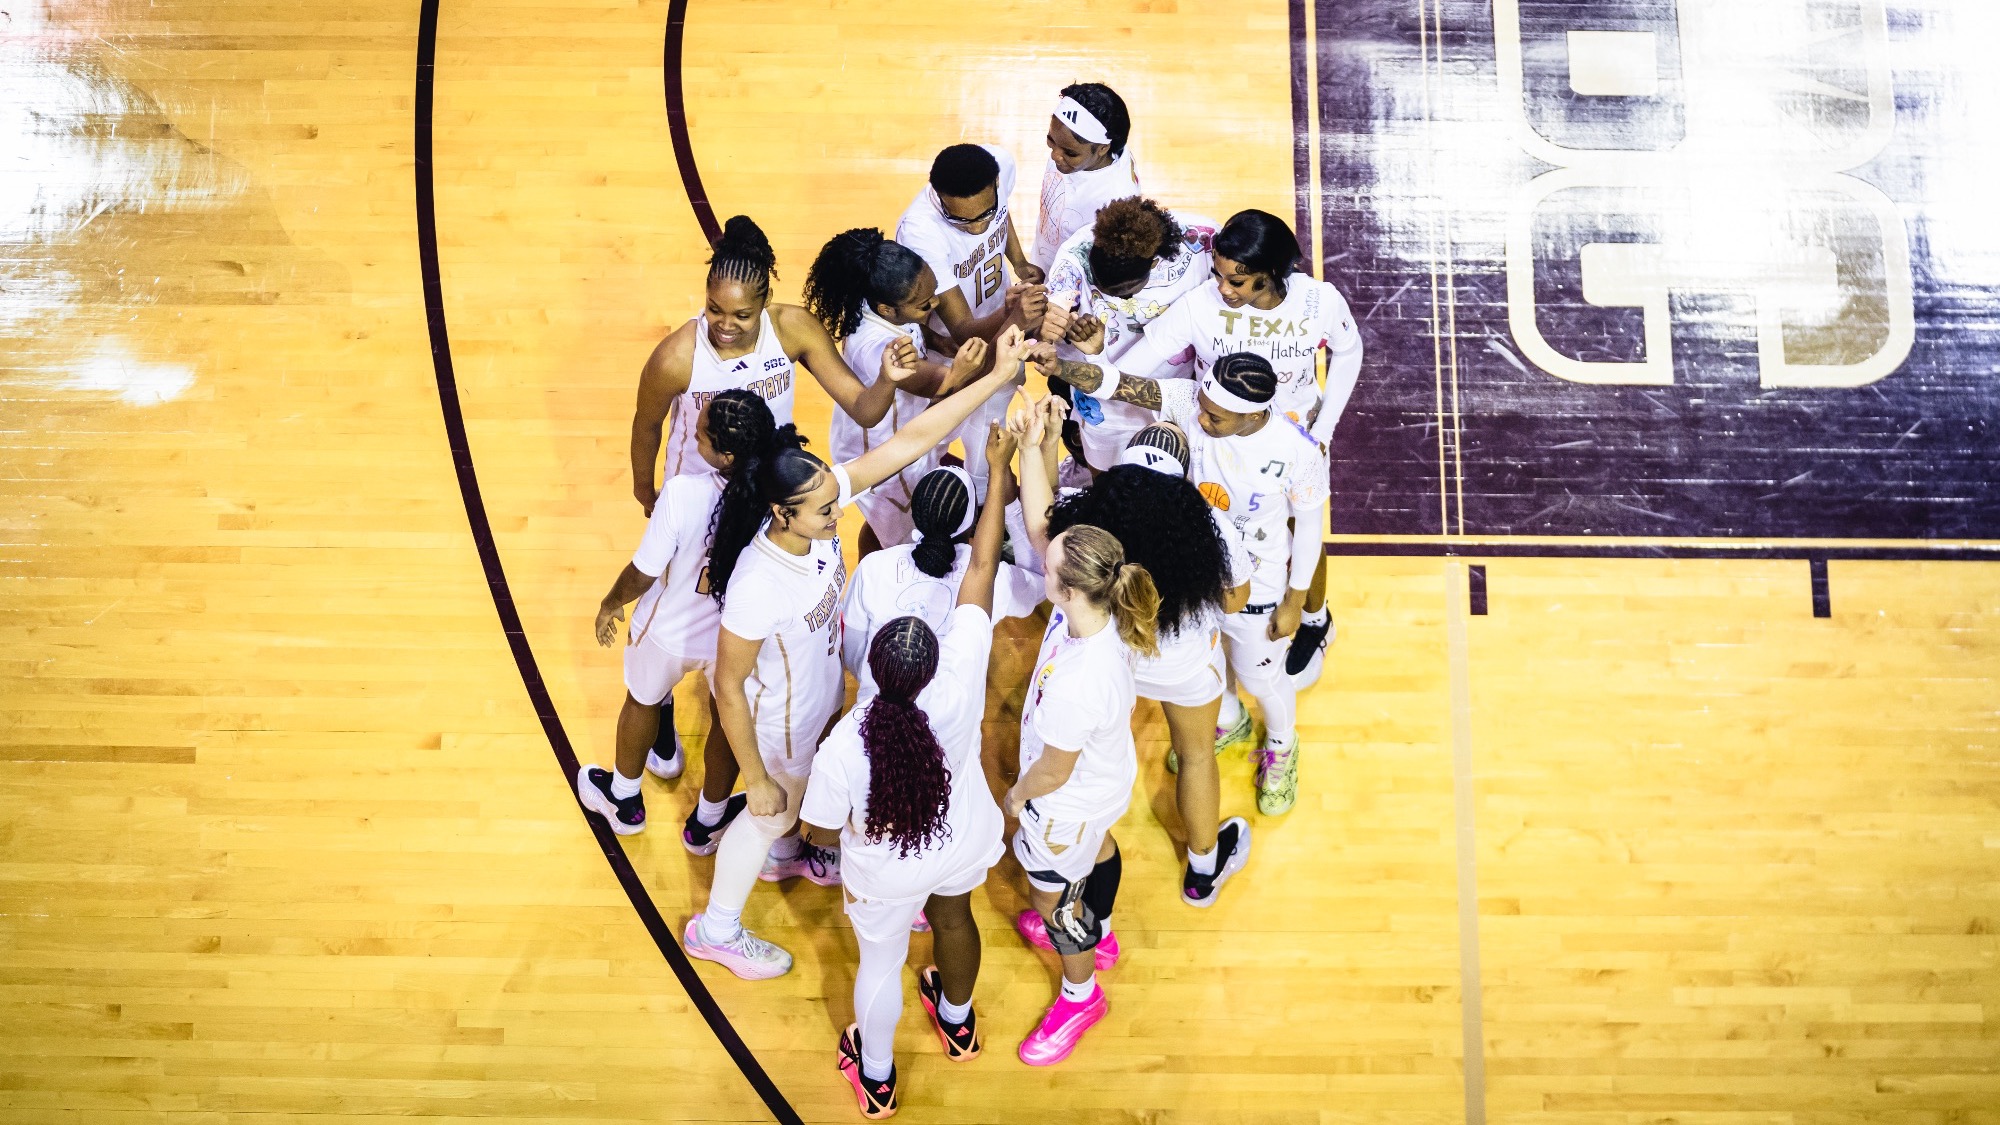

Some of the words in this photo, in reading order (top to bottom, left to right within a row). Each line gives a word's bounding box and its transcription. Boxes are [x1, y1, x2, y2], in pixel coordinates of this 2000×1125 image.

[953, 242, 986, 279] TEXAS
[974, 252, 1003, 309] 13
[1218, 309, 1310, 338] TEXAS
[763, 357, 786, 372] SBC
[1271, 340, 1315, 360] Harbor
[1248, 491, 1266, 512] 5
[803, 582, 838, 633] TEXAS
